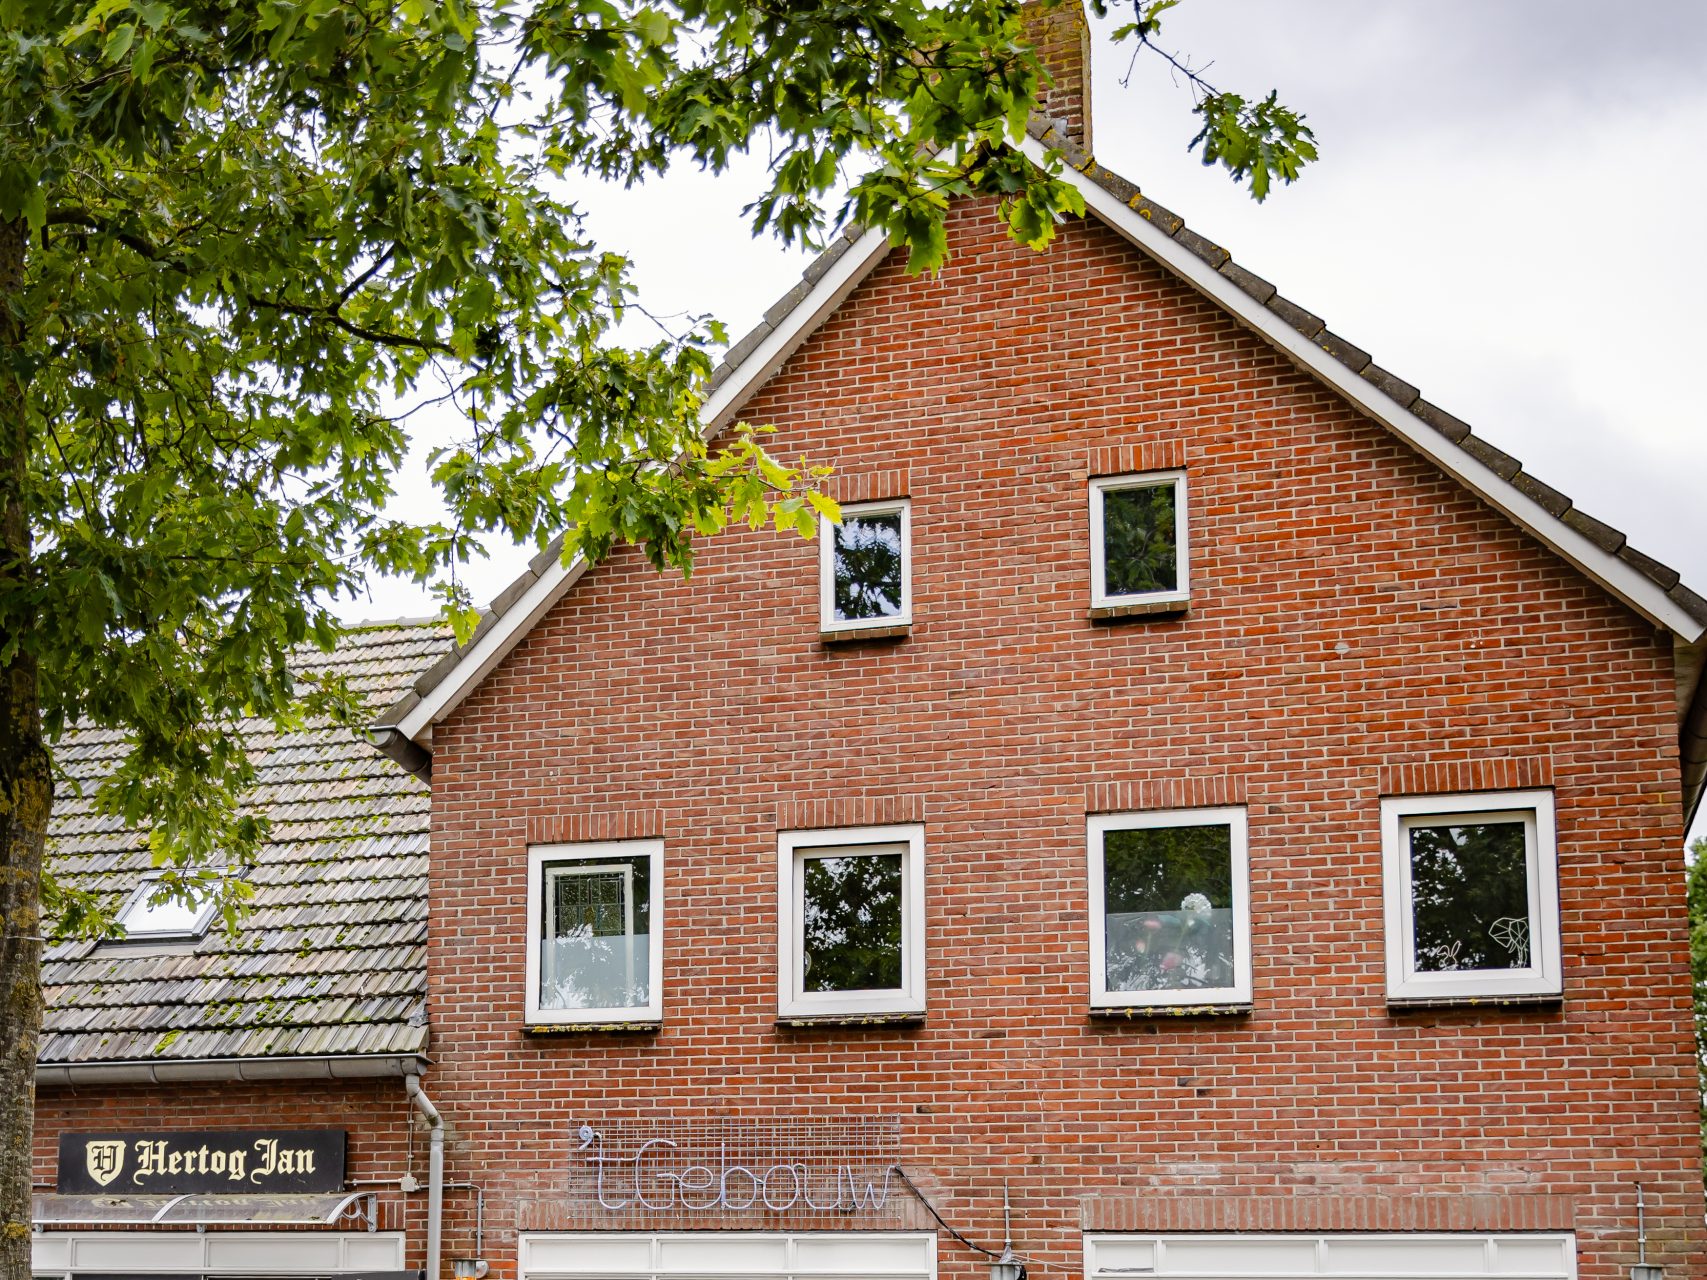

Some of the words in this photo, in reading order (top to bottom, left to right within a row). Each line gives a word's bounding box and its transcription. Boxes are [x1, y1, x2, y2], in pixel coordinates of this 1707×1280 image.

[133, 1140, 247, 1186] Hertog
[250, 1138, 316, 1185] Jan
[635, 1138, 896, 1211] Gebouw
